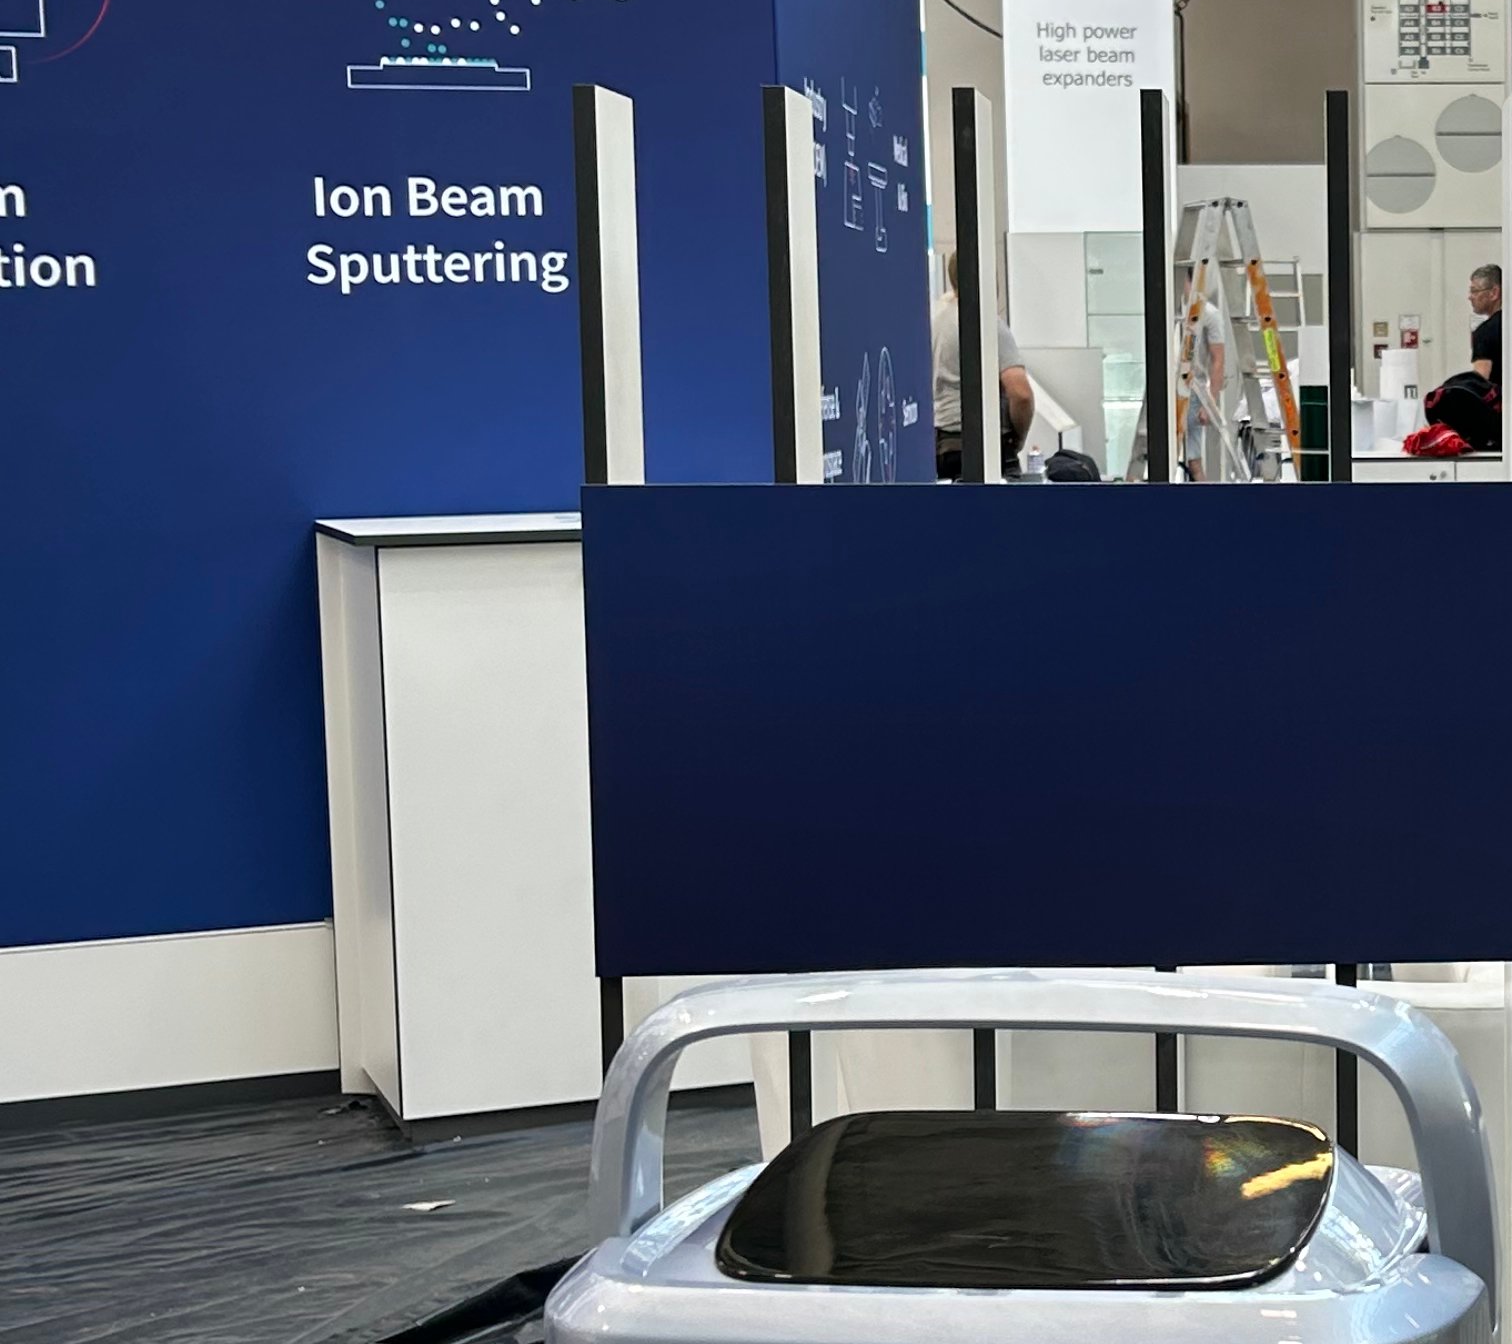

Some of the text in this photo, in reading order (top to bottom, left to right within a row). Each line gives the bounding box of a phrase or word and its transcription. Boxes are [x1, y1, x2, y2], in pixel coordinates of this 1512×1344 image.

[1036, 22, 1138, 43] High power
[1039, 45, 1136, 64] laser beam
[1042, 70, 1134, 90] expanders
[314, 177, 544, 218] Ion Beam
[305, 240, 571, 293] Sputtering
